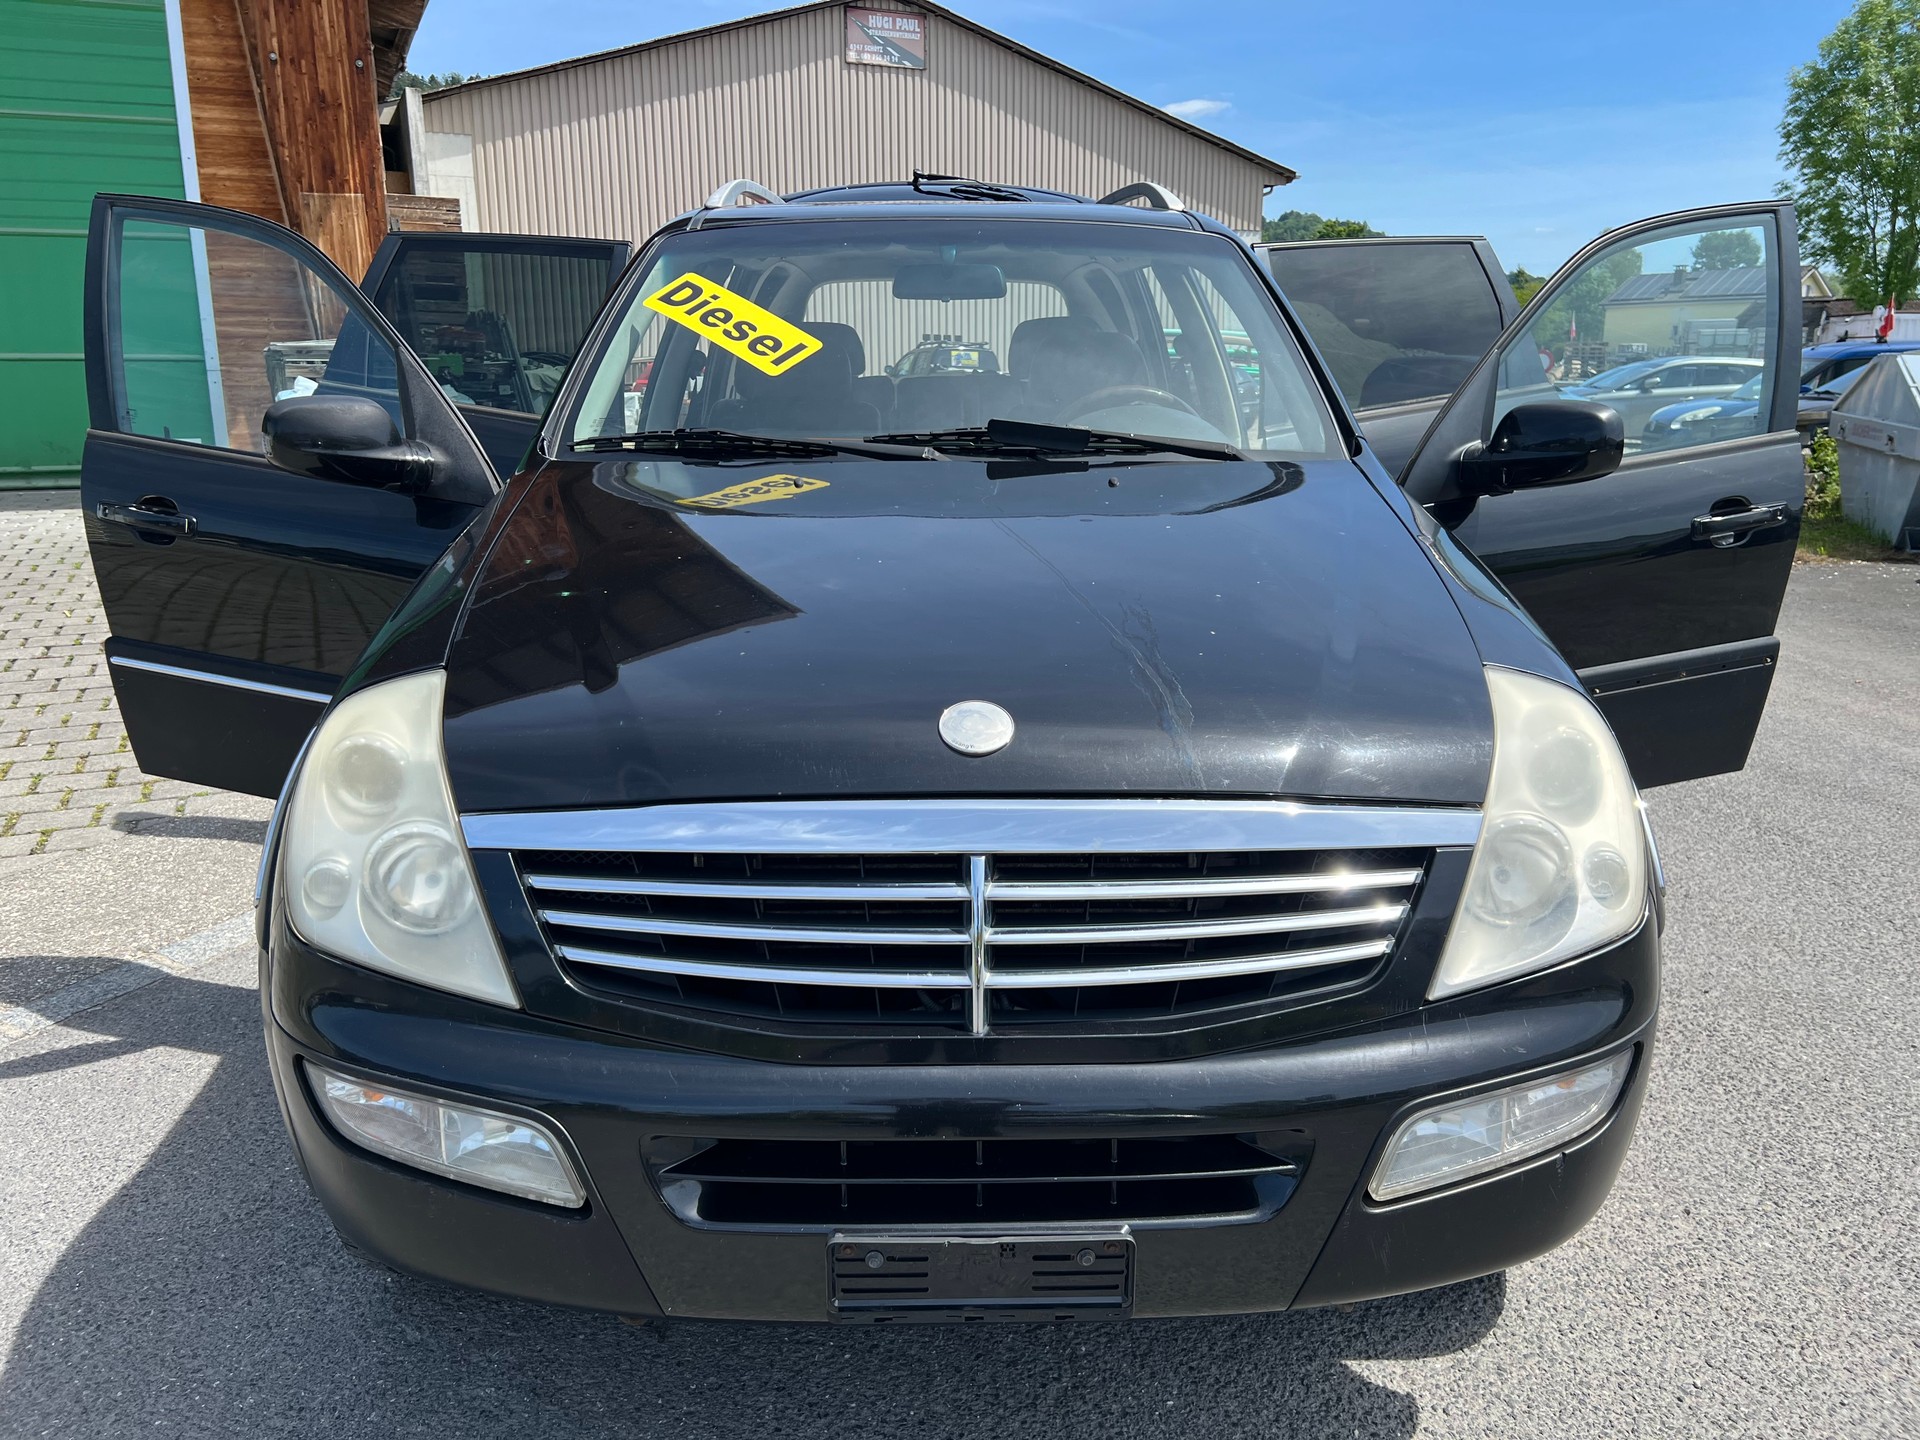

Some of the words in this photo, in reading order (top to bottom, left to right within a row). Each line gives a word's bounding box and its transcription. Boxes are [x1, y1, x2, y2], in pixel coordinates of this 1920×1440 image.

[868, 13, 893, 29] HÜGI
[895, 17, 921, 32] PAUL
[656, 280, 808, 367] Diesel
